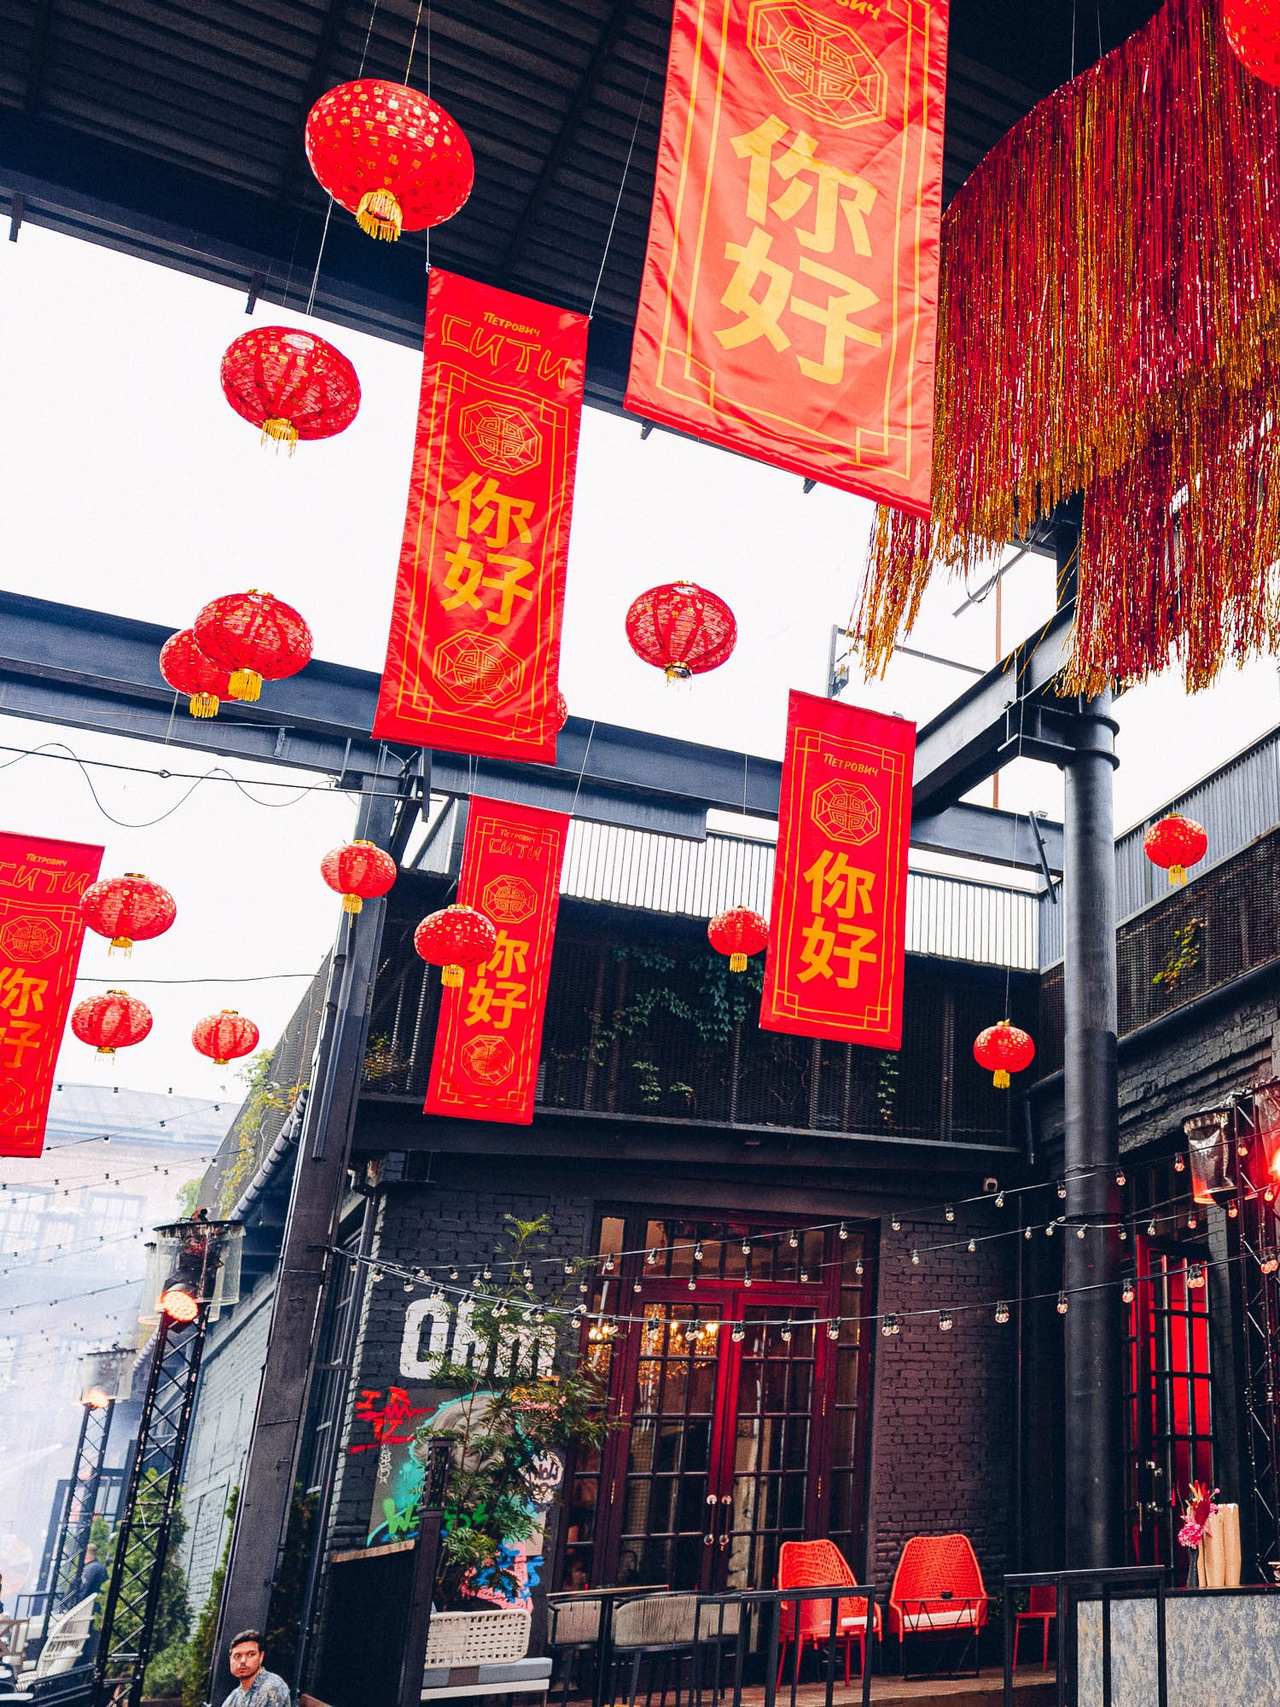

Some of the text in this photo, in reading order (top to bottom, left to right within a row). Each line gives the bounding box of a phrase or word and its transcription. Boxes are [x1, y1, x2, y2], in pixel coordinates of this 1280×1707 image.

[712, 113, 882, 385] 你好
[441, 314, 572, 389] СИТИ
[440, 471, 536, 626] 你好
[488, 838, 542, 861] СИТИ
[796, 849, 878, 989] 你好
